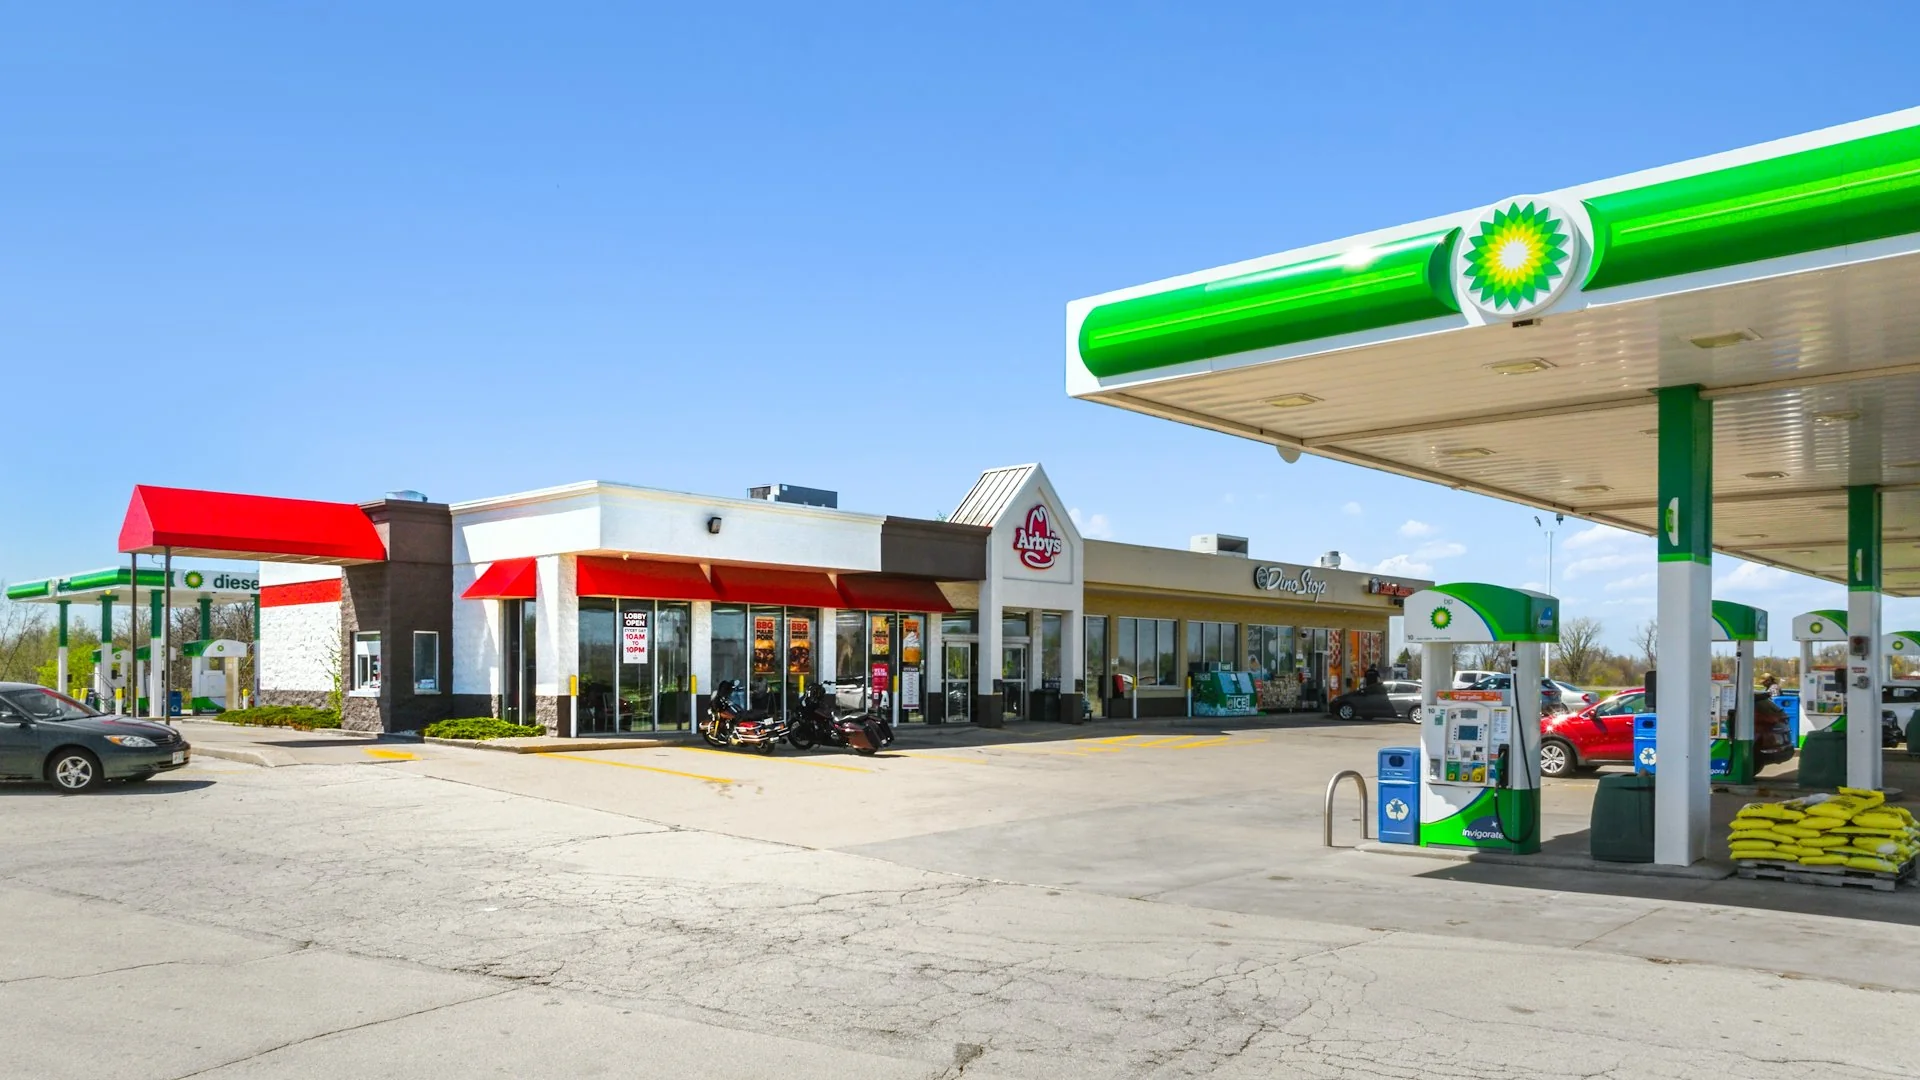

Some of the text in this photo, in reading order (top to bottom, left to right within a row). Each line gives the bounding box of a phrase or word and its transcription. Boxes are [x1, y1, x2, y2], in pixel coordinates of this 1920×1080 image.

[1016, 529, 1061, 557] Arby's
[213, 574, 260, 590] diese
[1267, 567, 1298, 592] Dino
[1296, 569, 1327, 603] Stop
[624, 612, 647, 620] LOBBY
[756, 621, 773, 629] BBQ
[791, 622, 808, 631] BBQ
[1233, 697, 1246, 709] ICE
[1462, 829, 1504, 840] Invigorate
